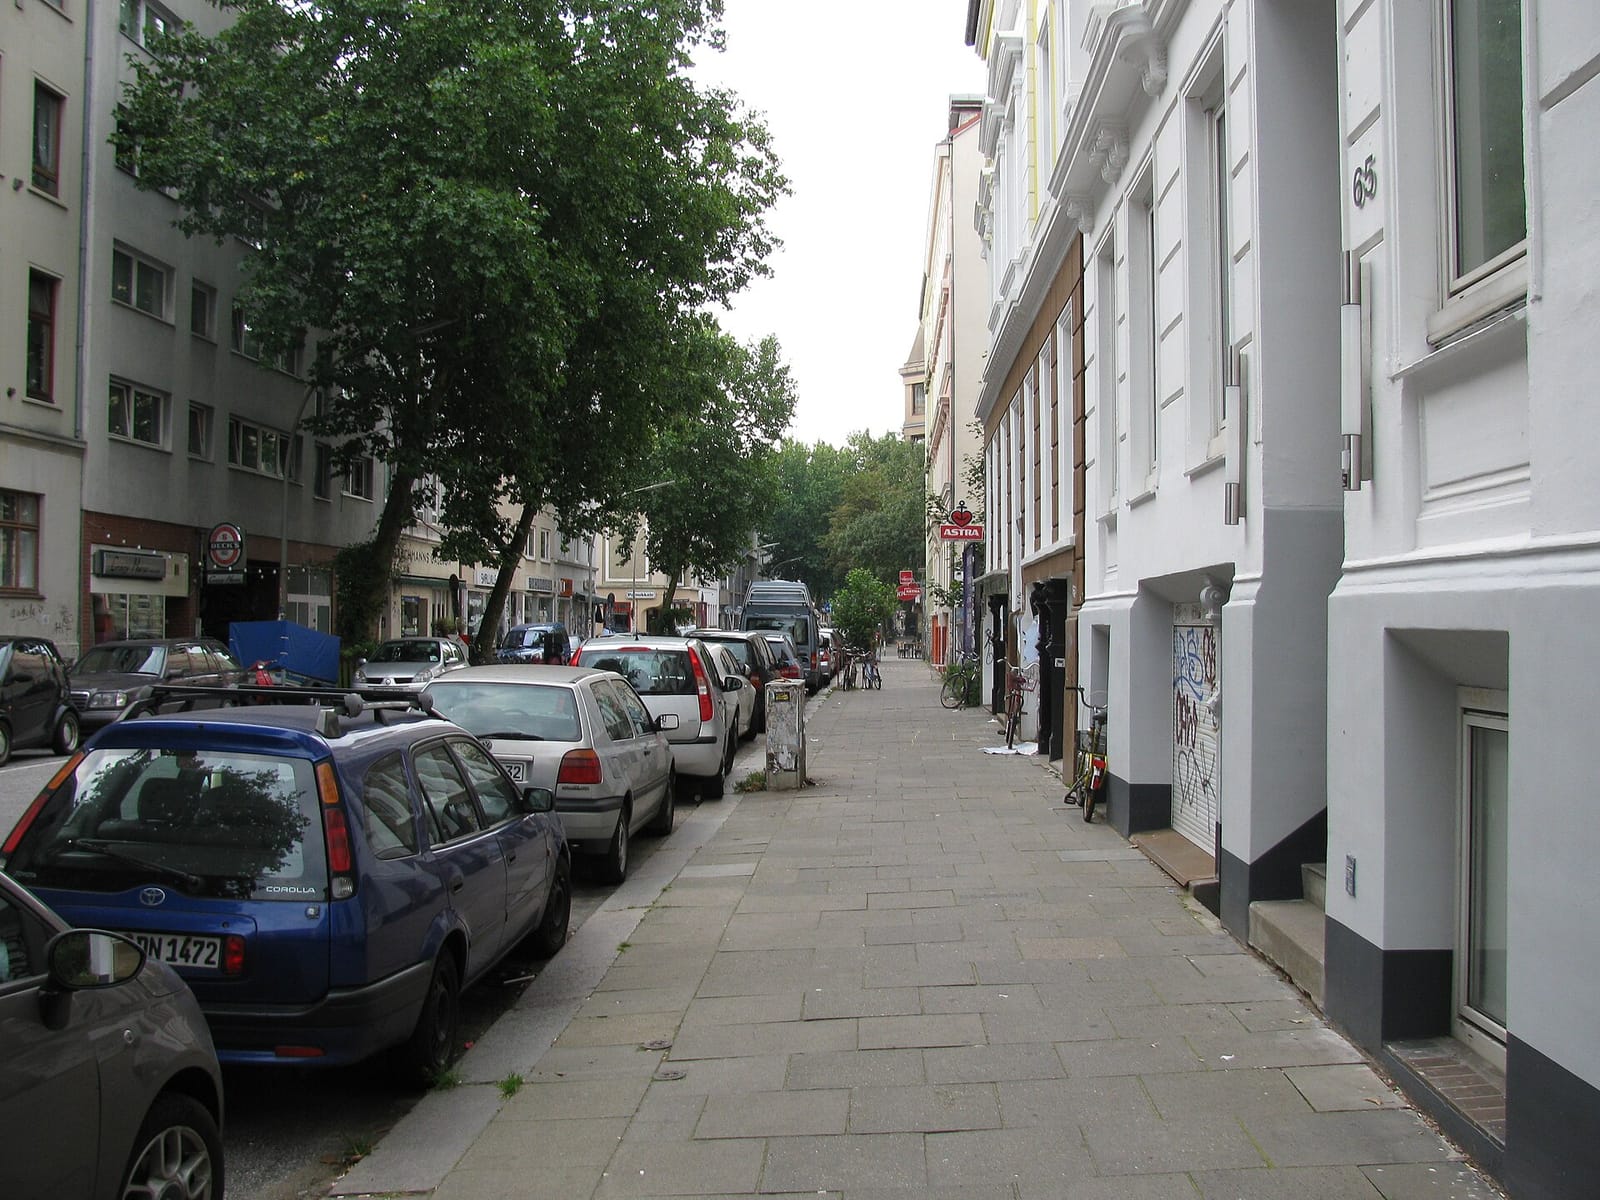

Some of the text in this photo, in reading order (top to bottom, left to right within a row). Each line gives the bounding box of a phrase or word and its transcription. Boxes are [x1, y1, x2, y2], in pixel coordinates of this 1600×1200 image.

[1353, 154, 1376, 208] 65
[943, 529, 980, 537] ASTRA
[265, 885, 316, 894] COROLLA
[165, 936, 218, 965] 1472
